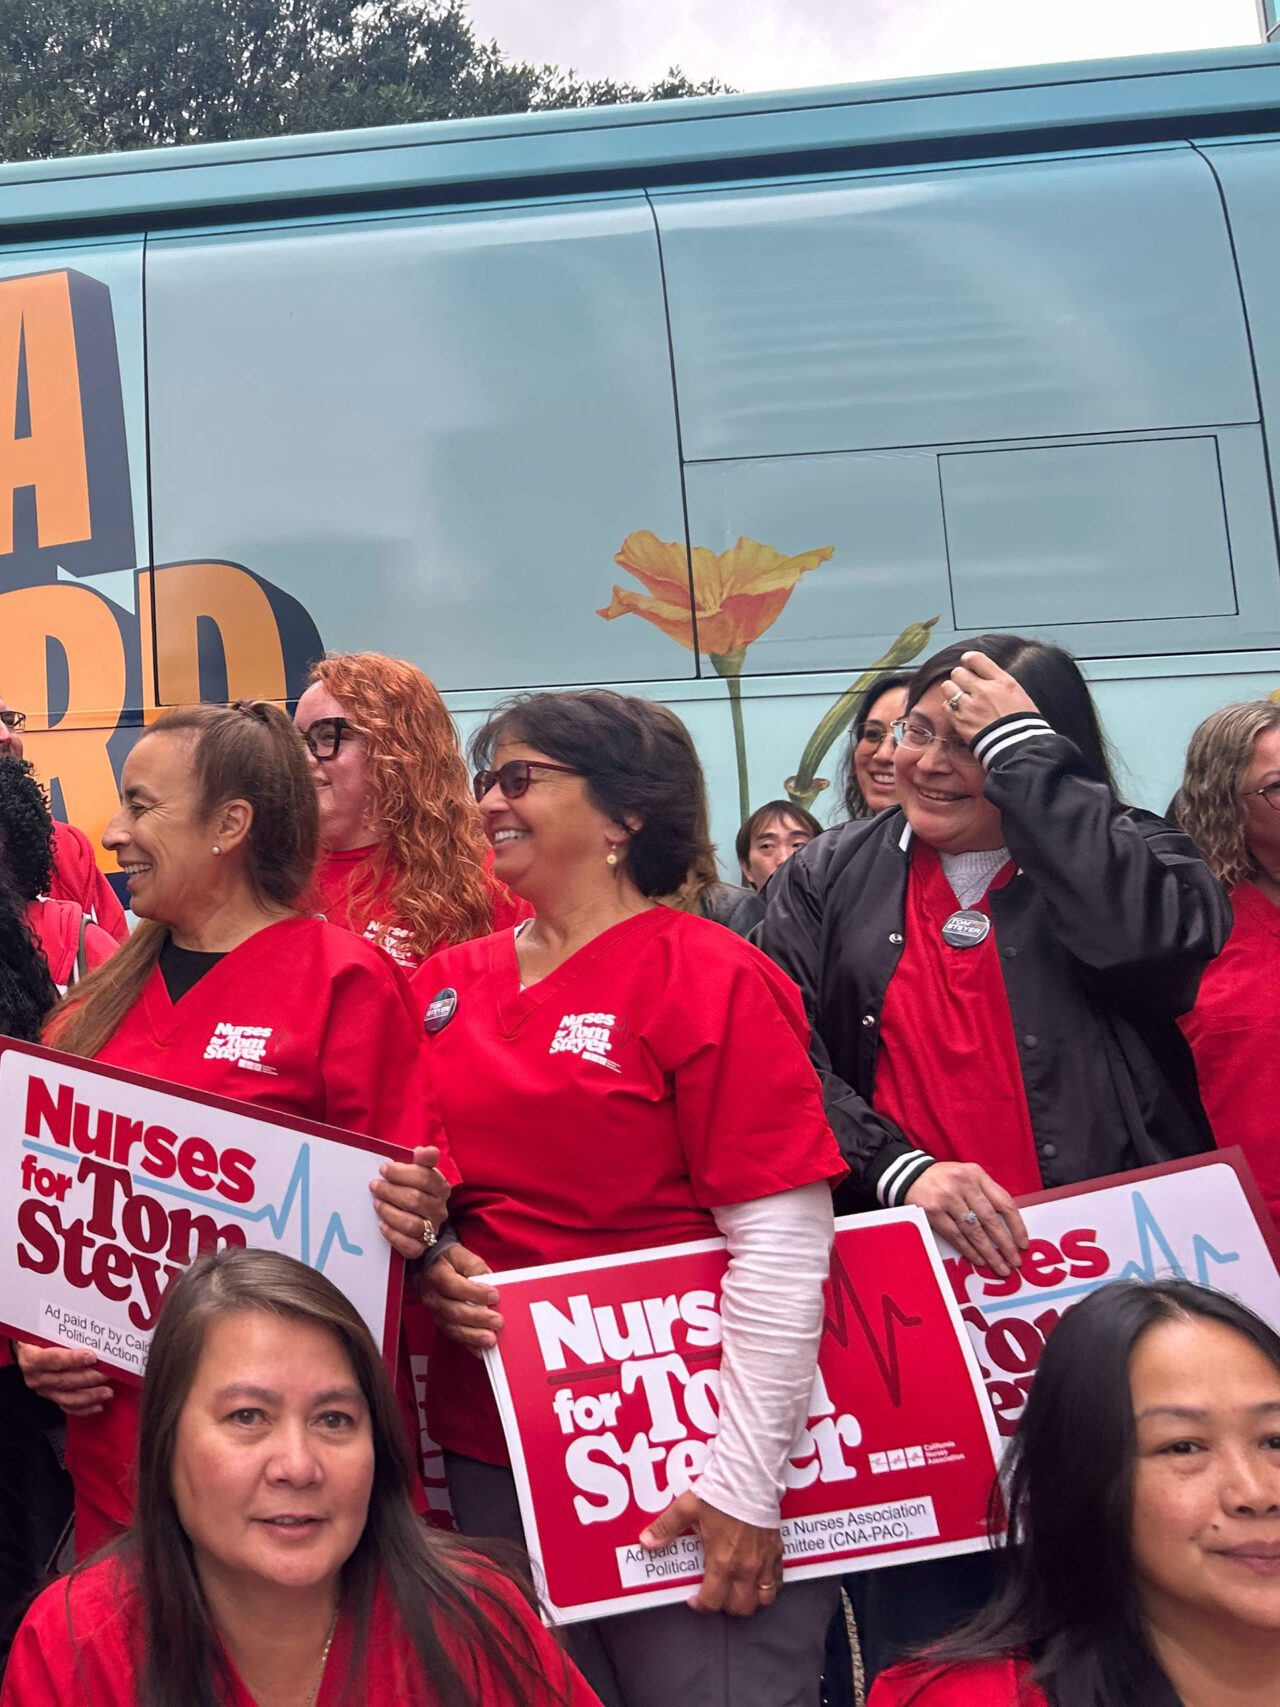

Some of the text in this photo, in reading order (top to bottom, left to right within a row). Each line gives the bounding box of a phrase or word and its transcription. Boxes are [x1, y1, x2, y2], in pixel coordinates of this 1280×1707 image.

[214, 1022, 273, 1038] Nurses
[226, 1036, 266, 1050] Tom
[559, 1012, 616, 1028] Nurses
[568, 1024, 611, 1043] Tom
[203, 1045, 267, 1062] Steyer
[549, 1037, 612, 1056] Steyer
[24, 1075, 257, 1204] Nurses
[21, 1154, 247, 1267] for Tom
[17, 1198, 184, 1331] Stey
[942, 1228, 1111, 1297] rses
[44, 1303, 61, 1320] Ad
[63, 1312, 88, 1330] paid
[90, 1320, 106, 1336] for
[108, 1326, 123, 1345] by
[58, 1323, 101, 1350] Political
[103, 1341, 139, 1364] Action
[529, 1290, 722, 1371] Nurs
[553, 1388, 622, 1434] for
[565, 1413, 862, 1525] Steer
[625, 1547, 645, 1564] Ad
[682, 1539, 701, 1553] for
[794, 1516, 845, 1535] Nurses
[847, 1503, 927, 1527] Association
[645, 1520, 914, 1578] Political mittee (CNA-PAC).
